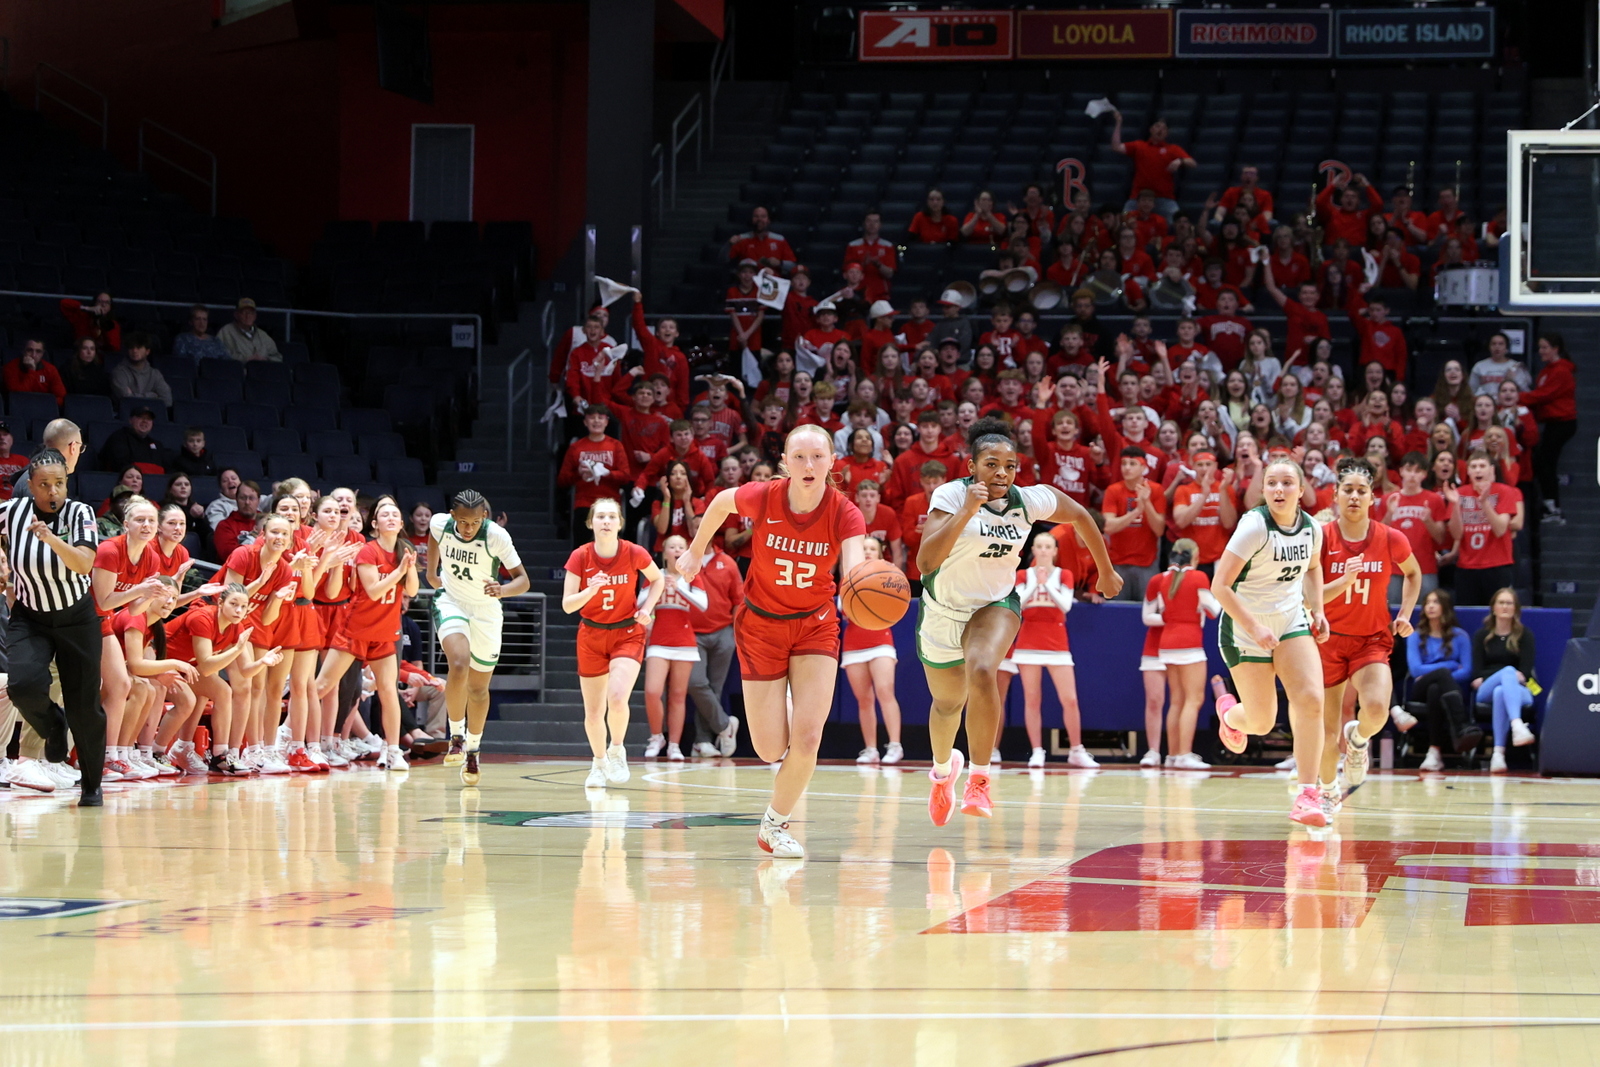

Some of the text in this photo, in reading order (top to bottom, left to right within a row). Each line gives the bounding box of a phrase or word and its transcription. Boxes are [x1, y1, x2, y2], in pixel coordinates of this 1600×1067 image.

[1053, 24, 1135, 44] LOYOLA
[1190, 22, 1318, 44] RICHMOND
[1345, 23, 1484, 43] RHODE ISLAND
[458, 462, 474, 472] 107
[980, 521, 1022, 540] LAUREL
[445, 545, 479, 565] LAUREL
[766, 533, 830, 557] BELLEVUE
[1273, 543, 1309, 562] LAUREL
[451, 563, 473, 581] 24
[774, 557, 817, 589] 32
[1276, 565, 1302, 582] 22
[1330, 561, 1383, 574] BEVUE
[586, 573, 629, 587] BEVUE
[601, 589, 615, 611] 2
[1344, 578, 1371, 605] 14
